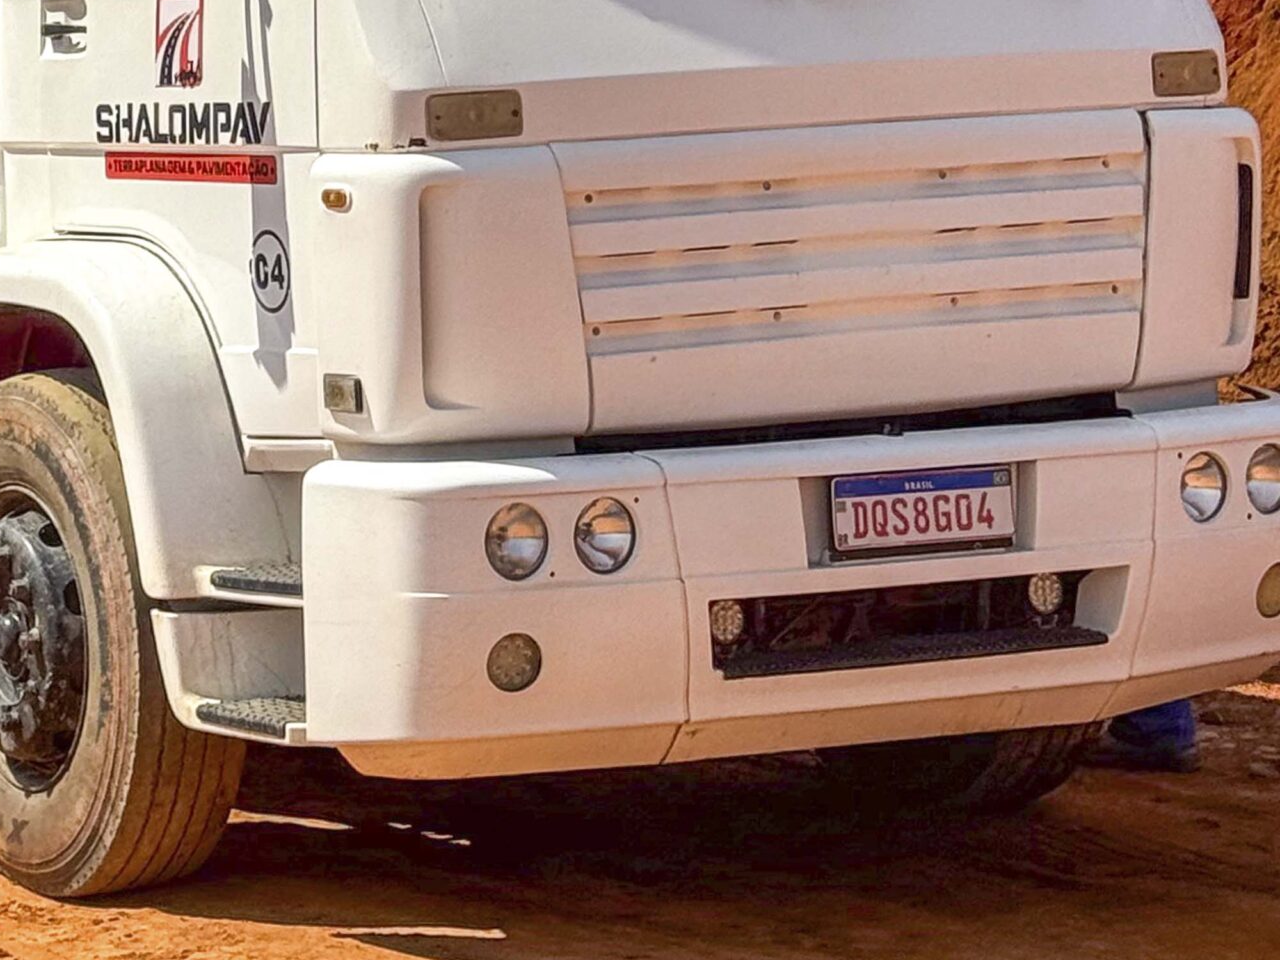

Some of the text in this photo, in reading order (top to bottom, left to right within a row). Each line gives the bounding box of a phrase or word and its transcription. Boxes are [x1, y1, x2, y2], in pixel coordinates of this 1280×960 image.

[96, 102, 271, 144] SHALOMPAV
[196, 160, 269, 179] PAVIMENTAÇÃO
[255, 253, 284, 289] 04
[904, 480, 935, 491] BRASIL
[852, 491, 995, 539] DQS8G04
